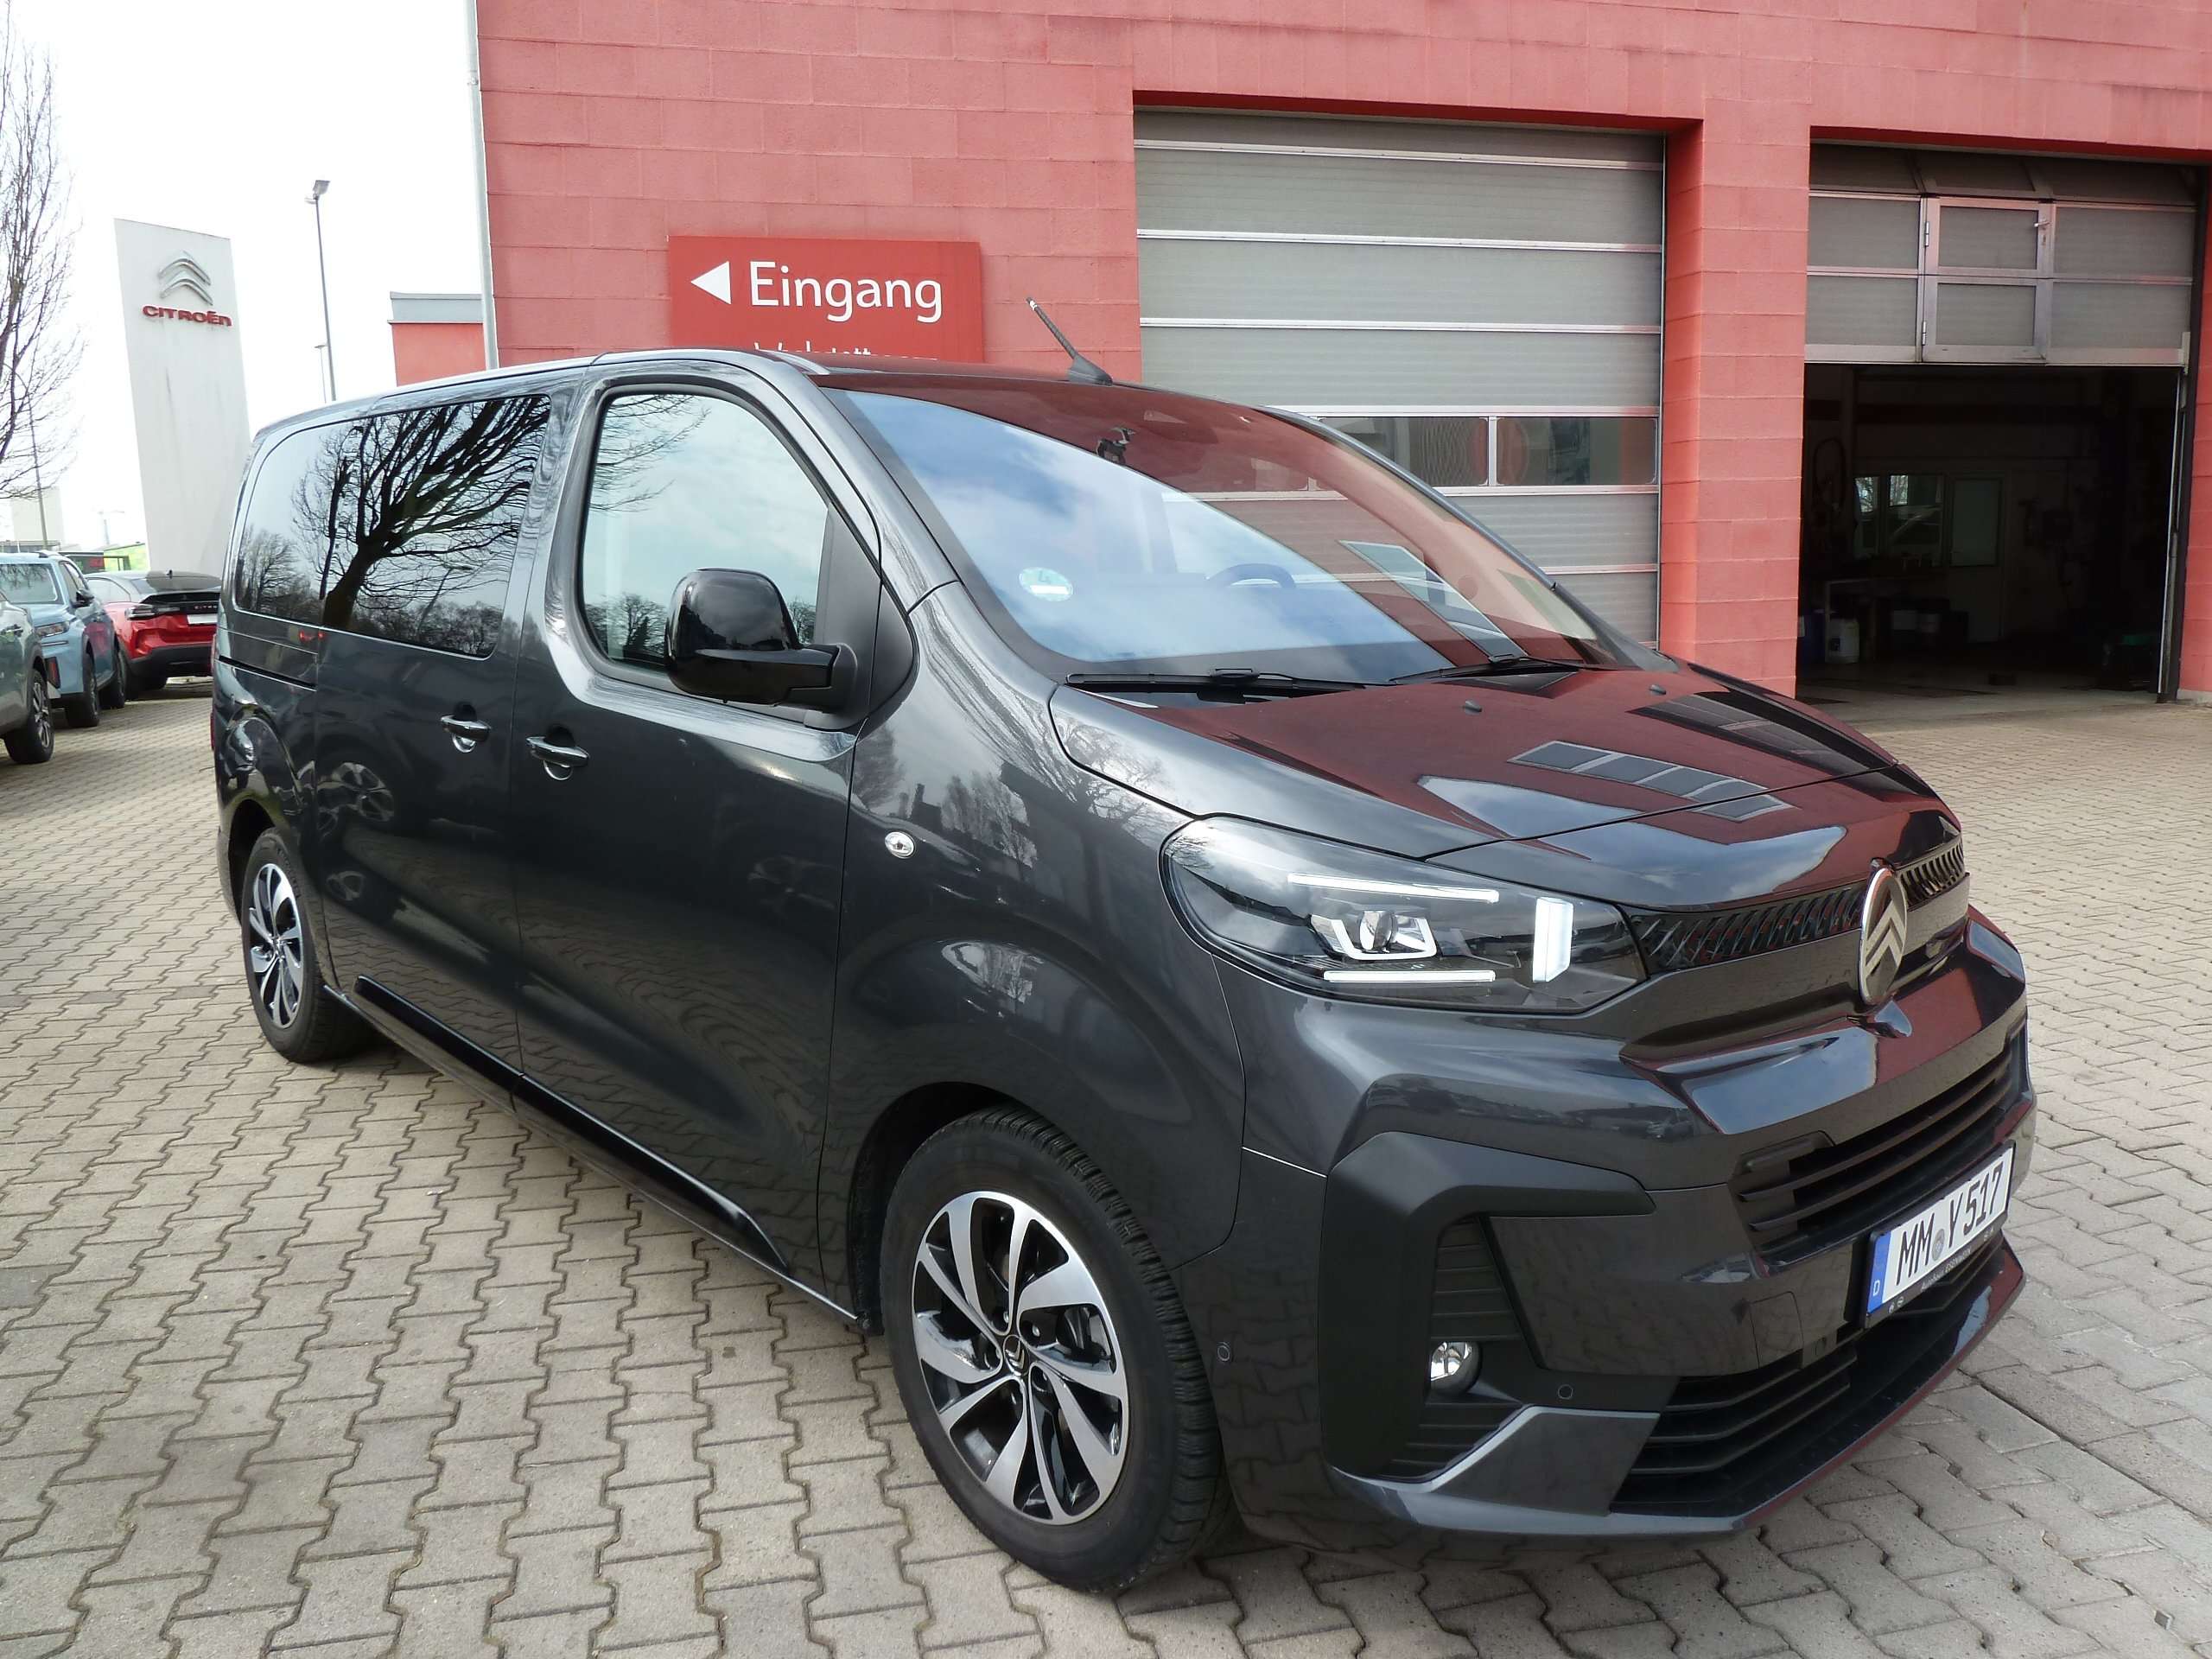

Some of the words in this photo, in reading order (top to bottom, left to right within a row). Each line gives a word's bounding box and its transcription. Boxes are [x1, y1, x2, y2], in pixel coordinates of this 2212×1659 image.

[749, 260, 943, 323] Eingang
[1872, 1280, 1880, 1296] D
[1896, 1211, 1935, 1286] MM
[1948, 1192, 1964, 1249] Y
[1963, 1161, 2004, 1236] 517
